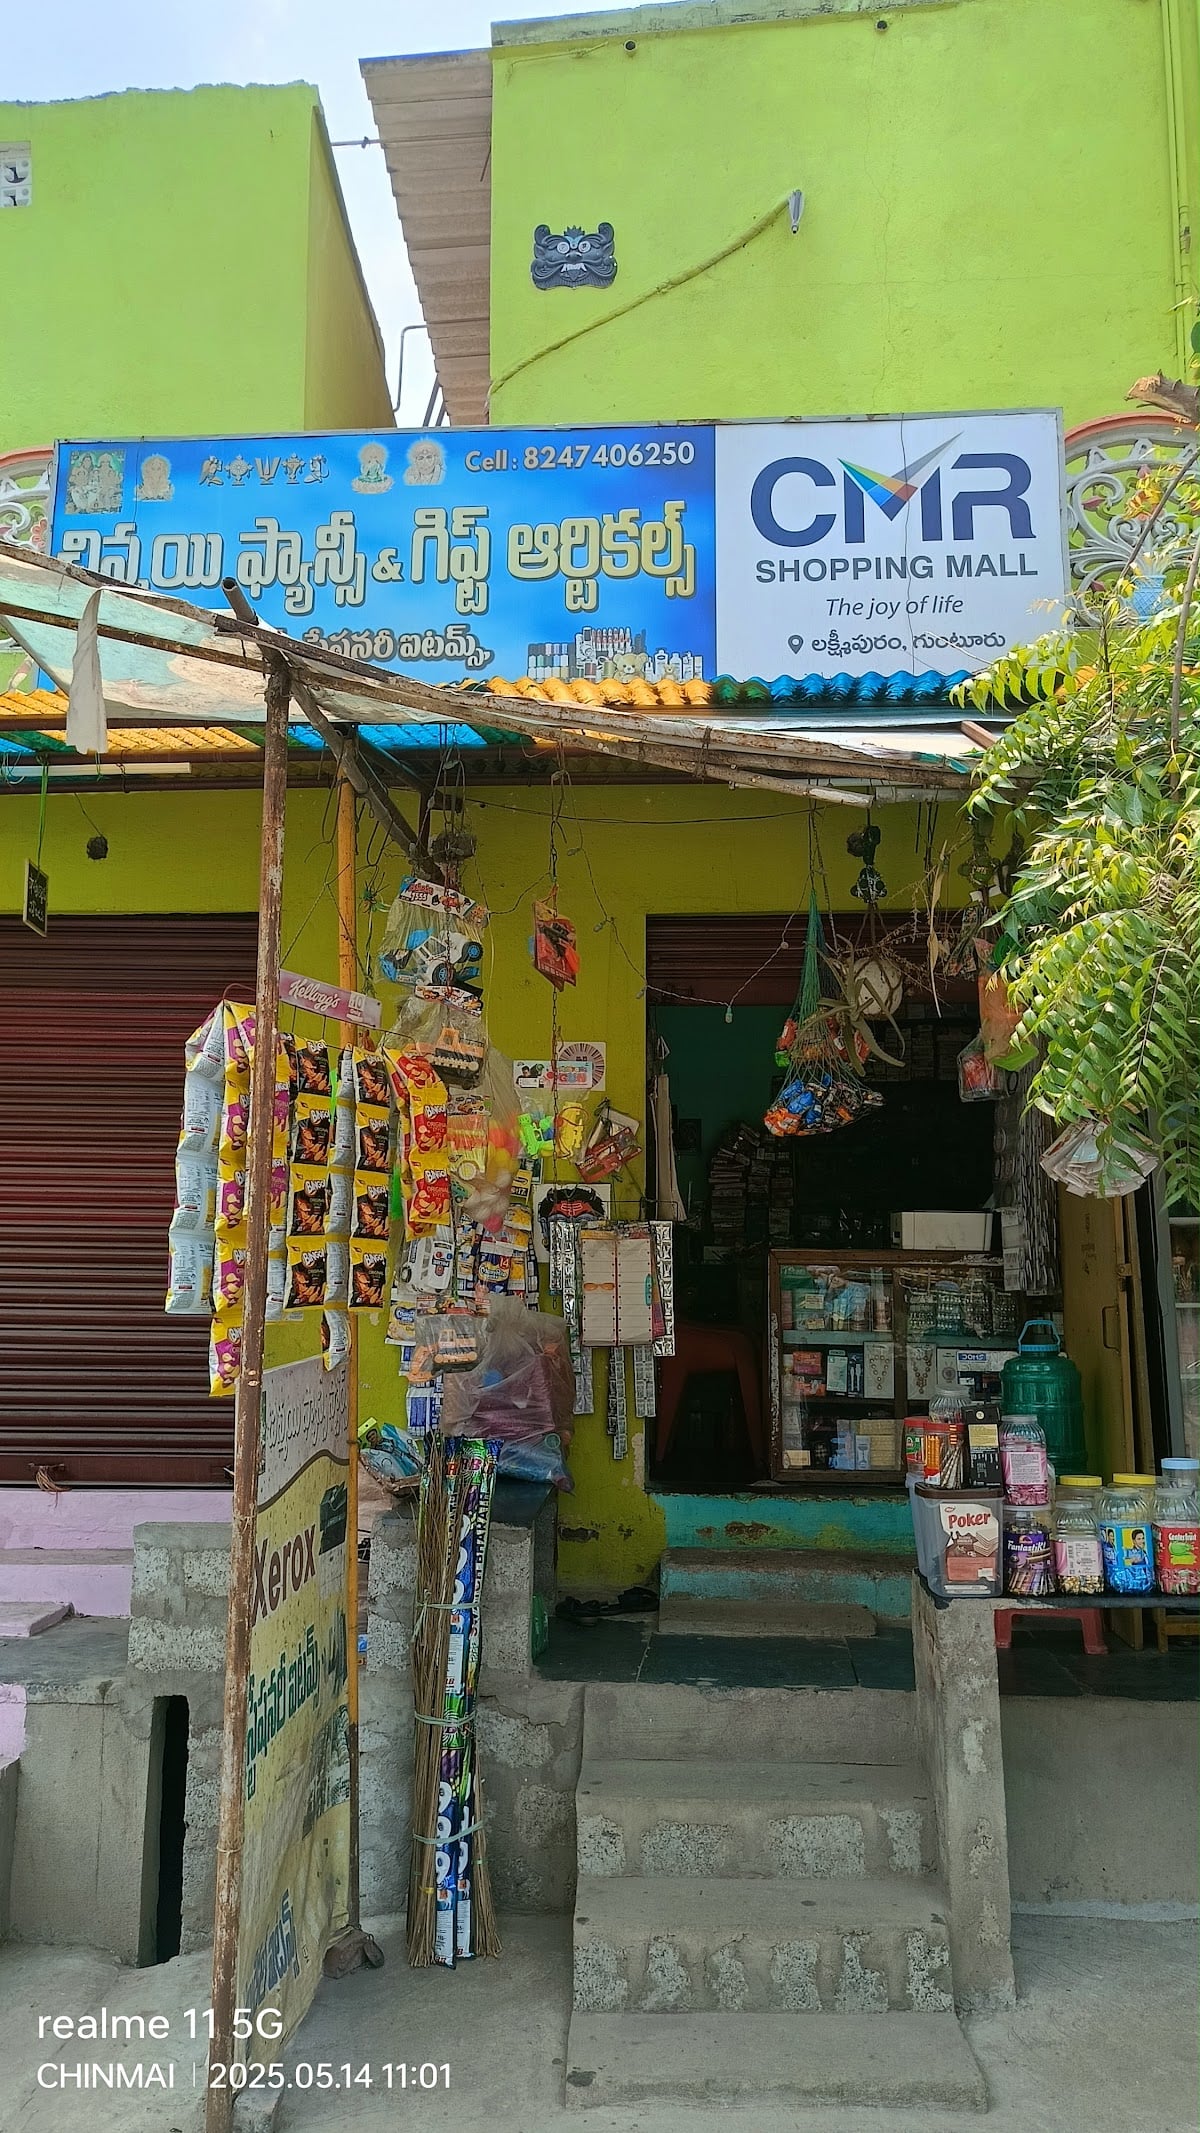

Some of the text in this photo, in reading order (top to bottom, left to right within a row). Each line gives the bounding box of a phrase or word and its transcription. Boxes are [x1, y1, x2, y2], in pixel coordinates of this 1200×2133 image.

[523, 441, 695, 470] 8247406250
[750, 431, 1037, 547] CMR
[373, 547, 405, 582] &
[411, 506, 491, 615] గిఫ్ట్
[507, 500, 696, 613] ఆర్టికల్స్
[755, 553, 1038, 583] SHOPPING MALL
[826, 595, 963, 620] The joy of life
[913, 631, 1006, 652] గుంటూరు
[288, 979, 341, 1012] Kellogg's
[948, 1513, 991, 1529] Poker
[252, 1524, 315, 1628] Xerox
